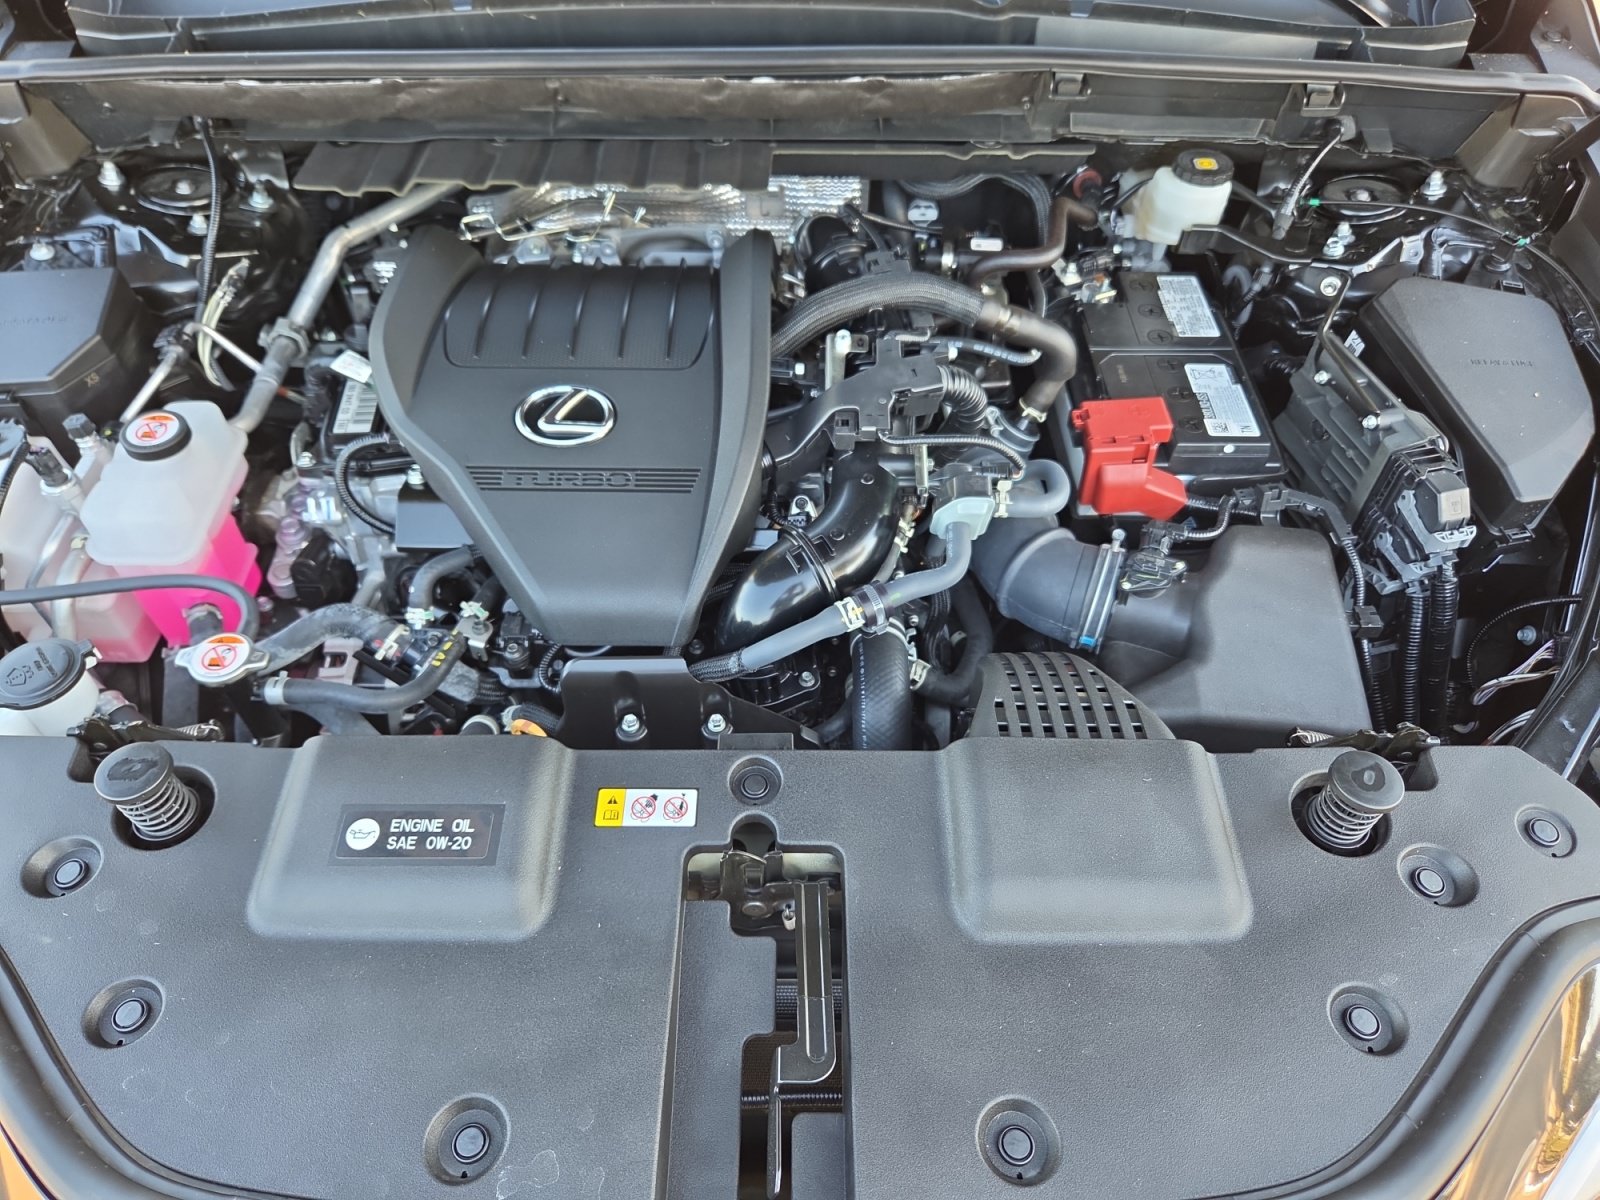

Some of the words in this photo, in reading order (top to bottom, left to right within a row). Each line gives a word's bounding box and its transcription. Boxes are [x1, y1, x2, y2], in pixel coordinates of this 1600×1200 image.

[506, 470, 632, 487] TURBO
[390, 818, 444, 832] ENGINE
[452, 818, 475, 832] OIL
[386, 836, 418, 849] SAE
[425, 836, 472, 850] 0W-20
